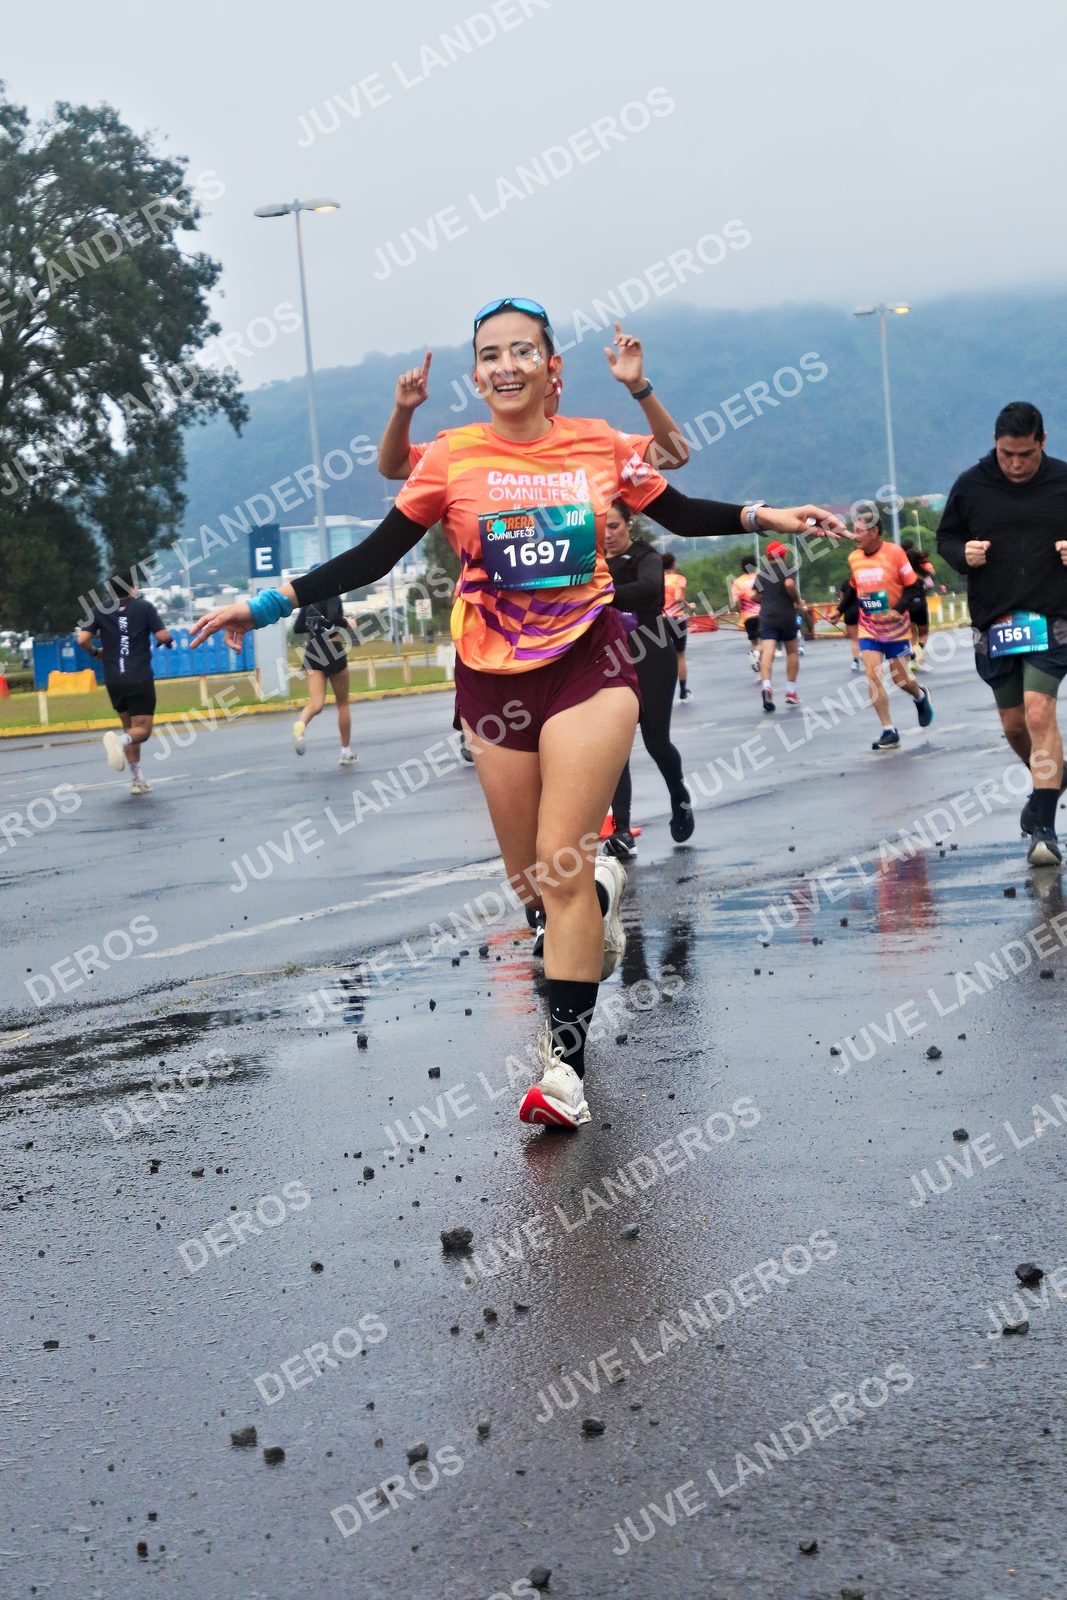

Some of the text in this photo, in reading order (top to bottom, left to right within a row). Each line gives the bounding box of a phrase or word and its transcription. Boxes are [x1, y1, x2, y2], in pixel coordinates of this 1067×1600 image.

[487, 468, 588, 486] CARRERA
[566, 510, 586, 526] 10K
[255, 546, 274, 571] E
[502, 539, 571, 568] 1697
[996, 626, 1031, 643] 1561
